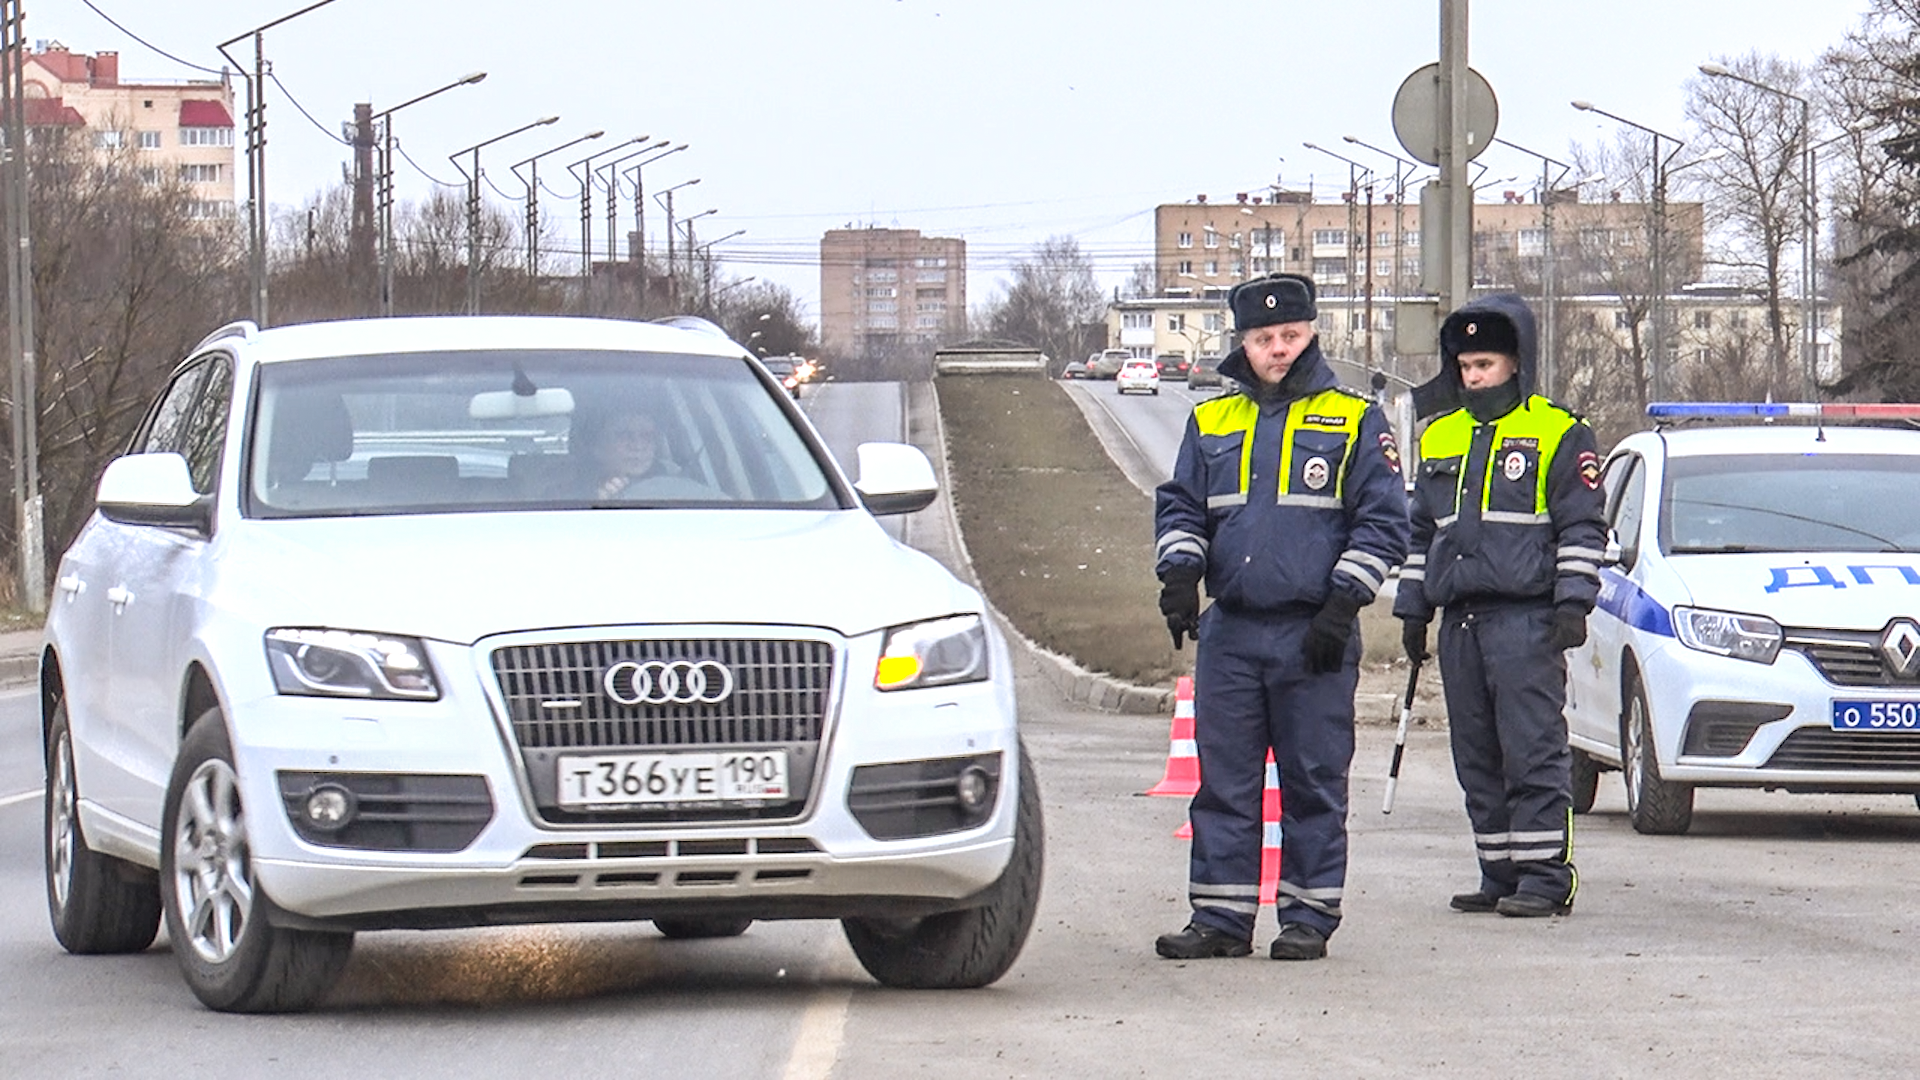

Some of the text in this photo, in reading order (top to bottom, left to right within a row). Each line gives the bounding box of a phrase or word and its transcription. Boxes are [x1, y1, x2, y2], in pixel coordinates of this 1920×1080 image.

[1870, 703, 1920, 727] 550
[573, 756, 778, 797] Т366УЕ 190
